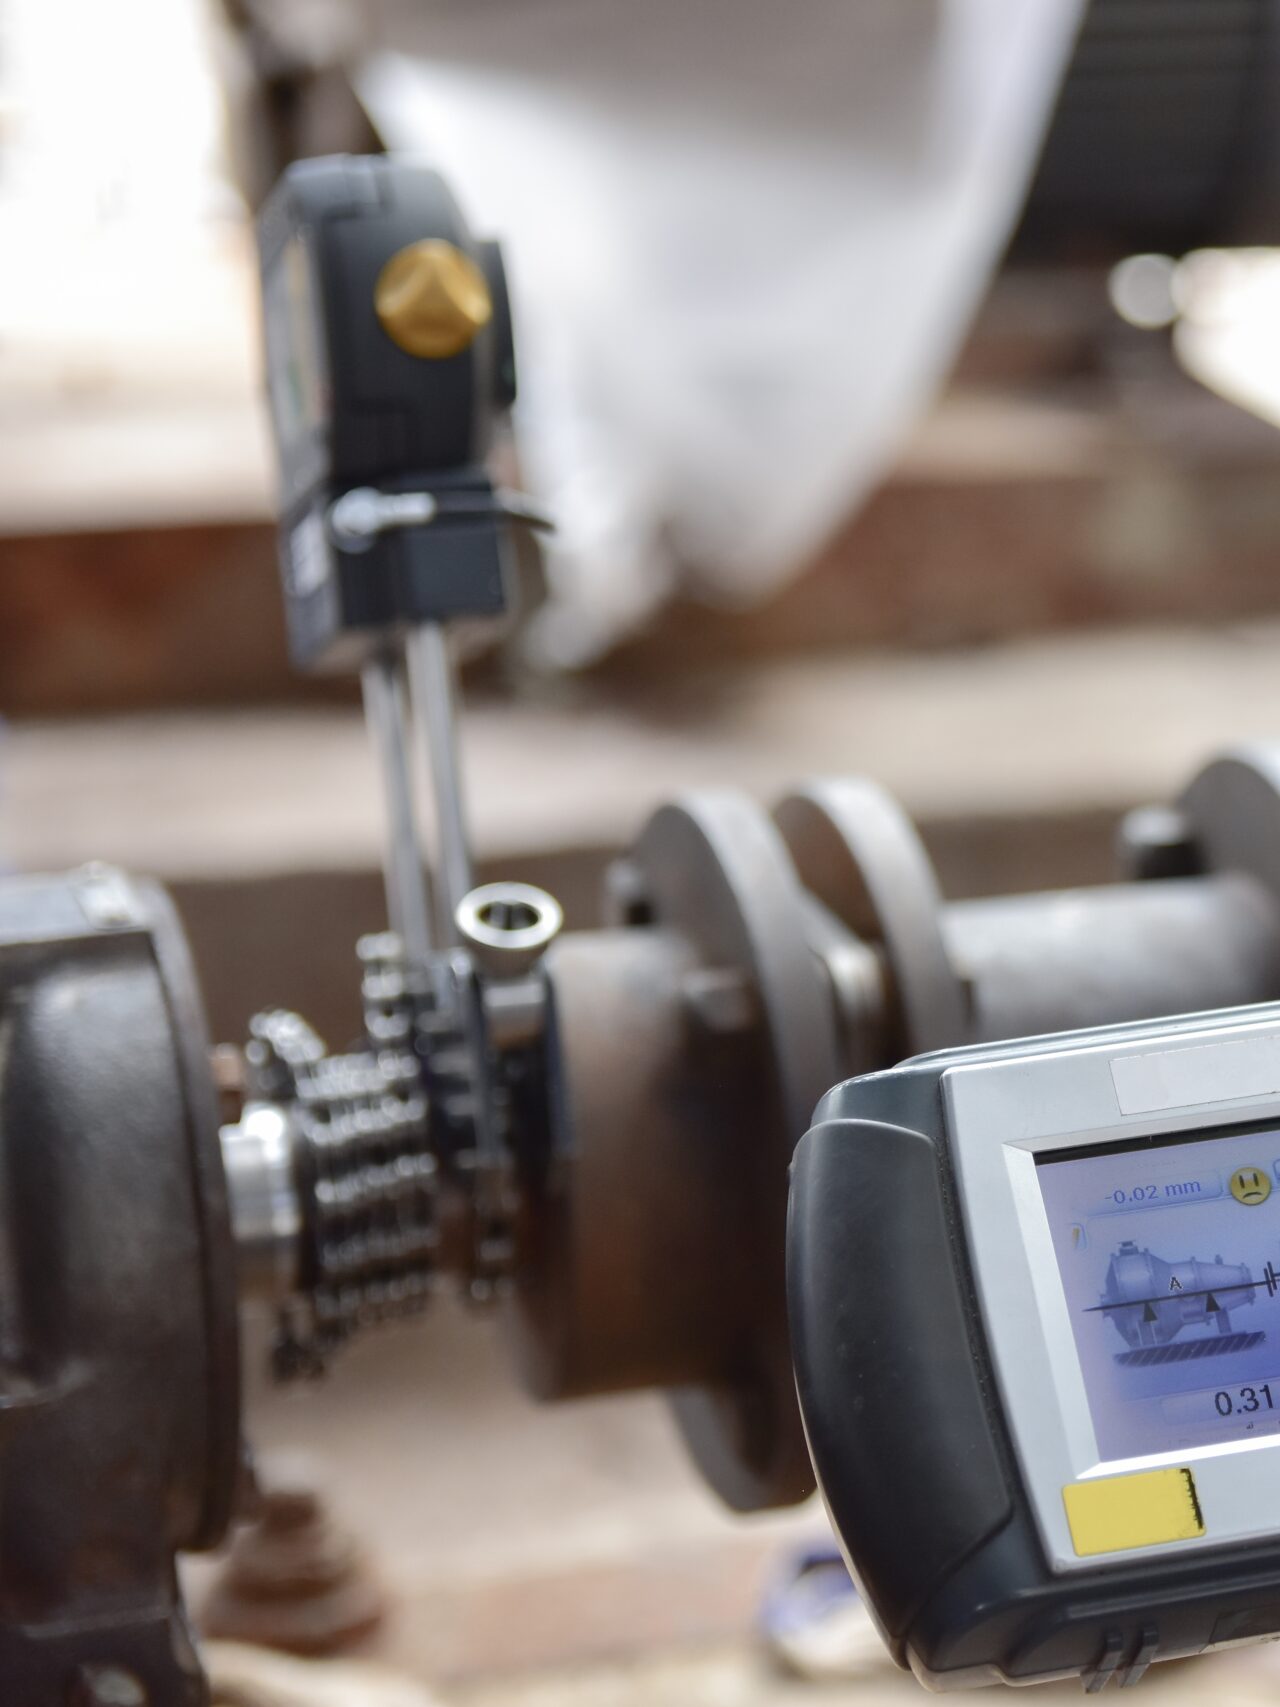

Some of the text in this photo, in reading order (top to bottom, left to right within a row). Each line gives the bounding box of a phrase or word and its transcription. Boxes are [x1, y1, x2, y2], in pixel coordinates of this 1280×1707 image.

[1104, 1180, 1201, 1204] -0.02 mm
[1169, 1277, 1183, 1291] A
[1214, 1384, 1274, 1416] 0.31
